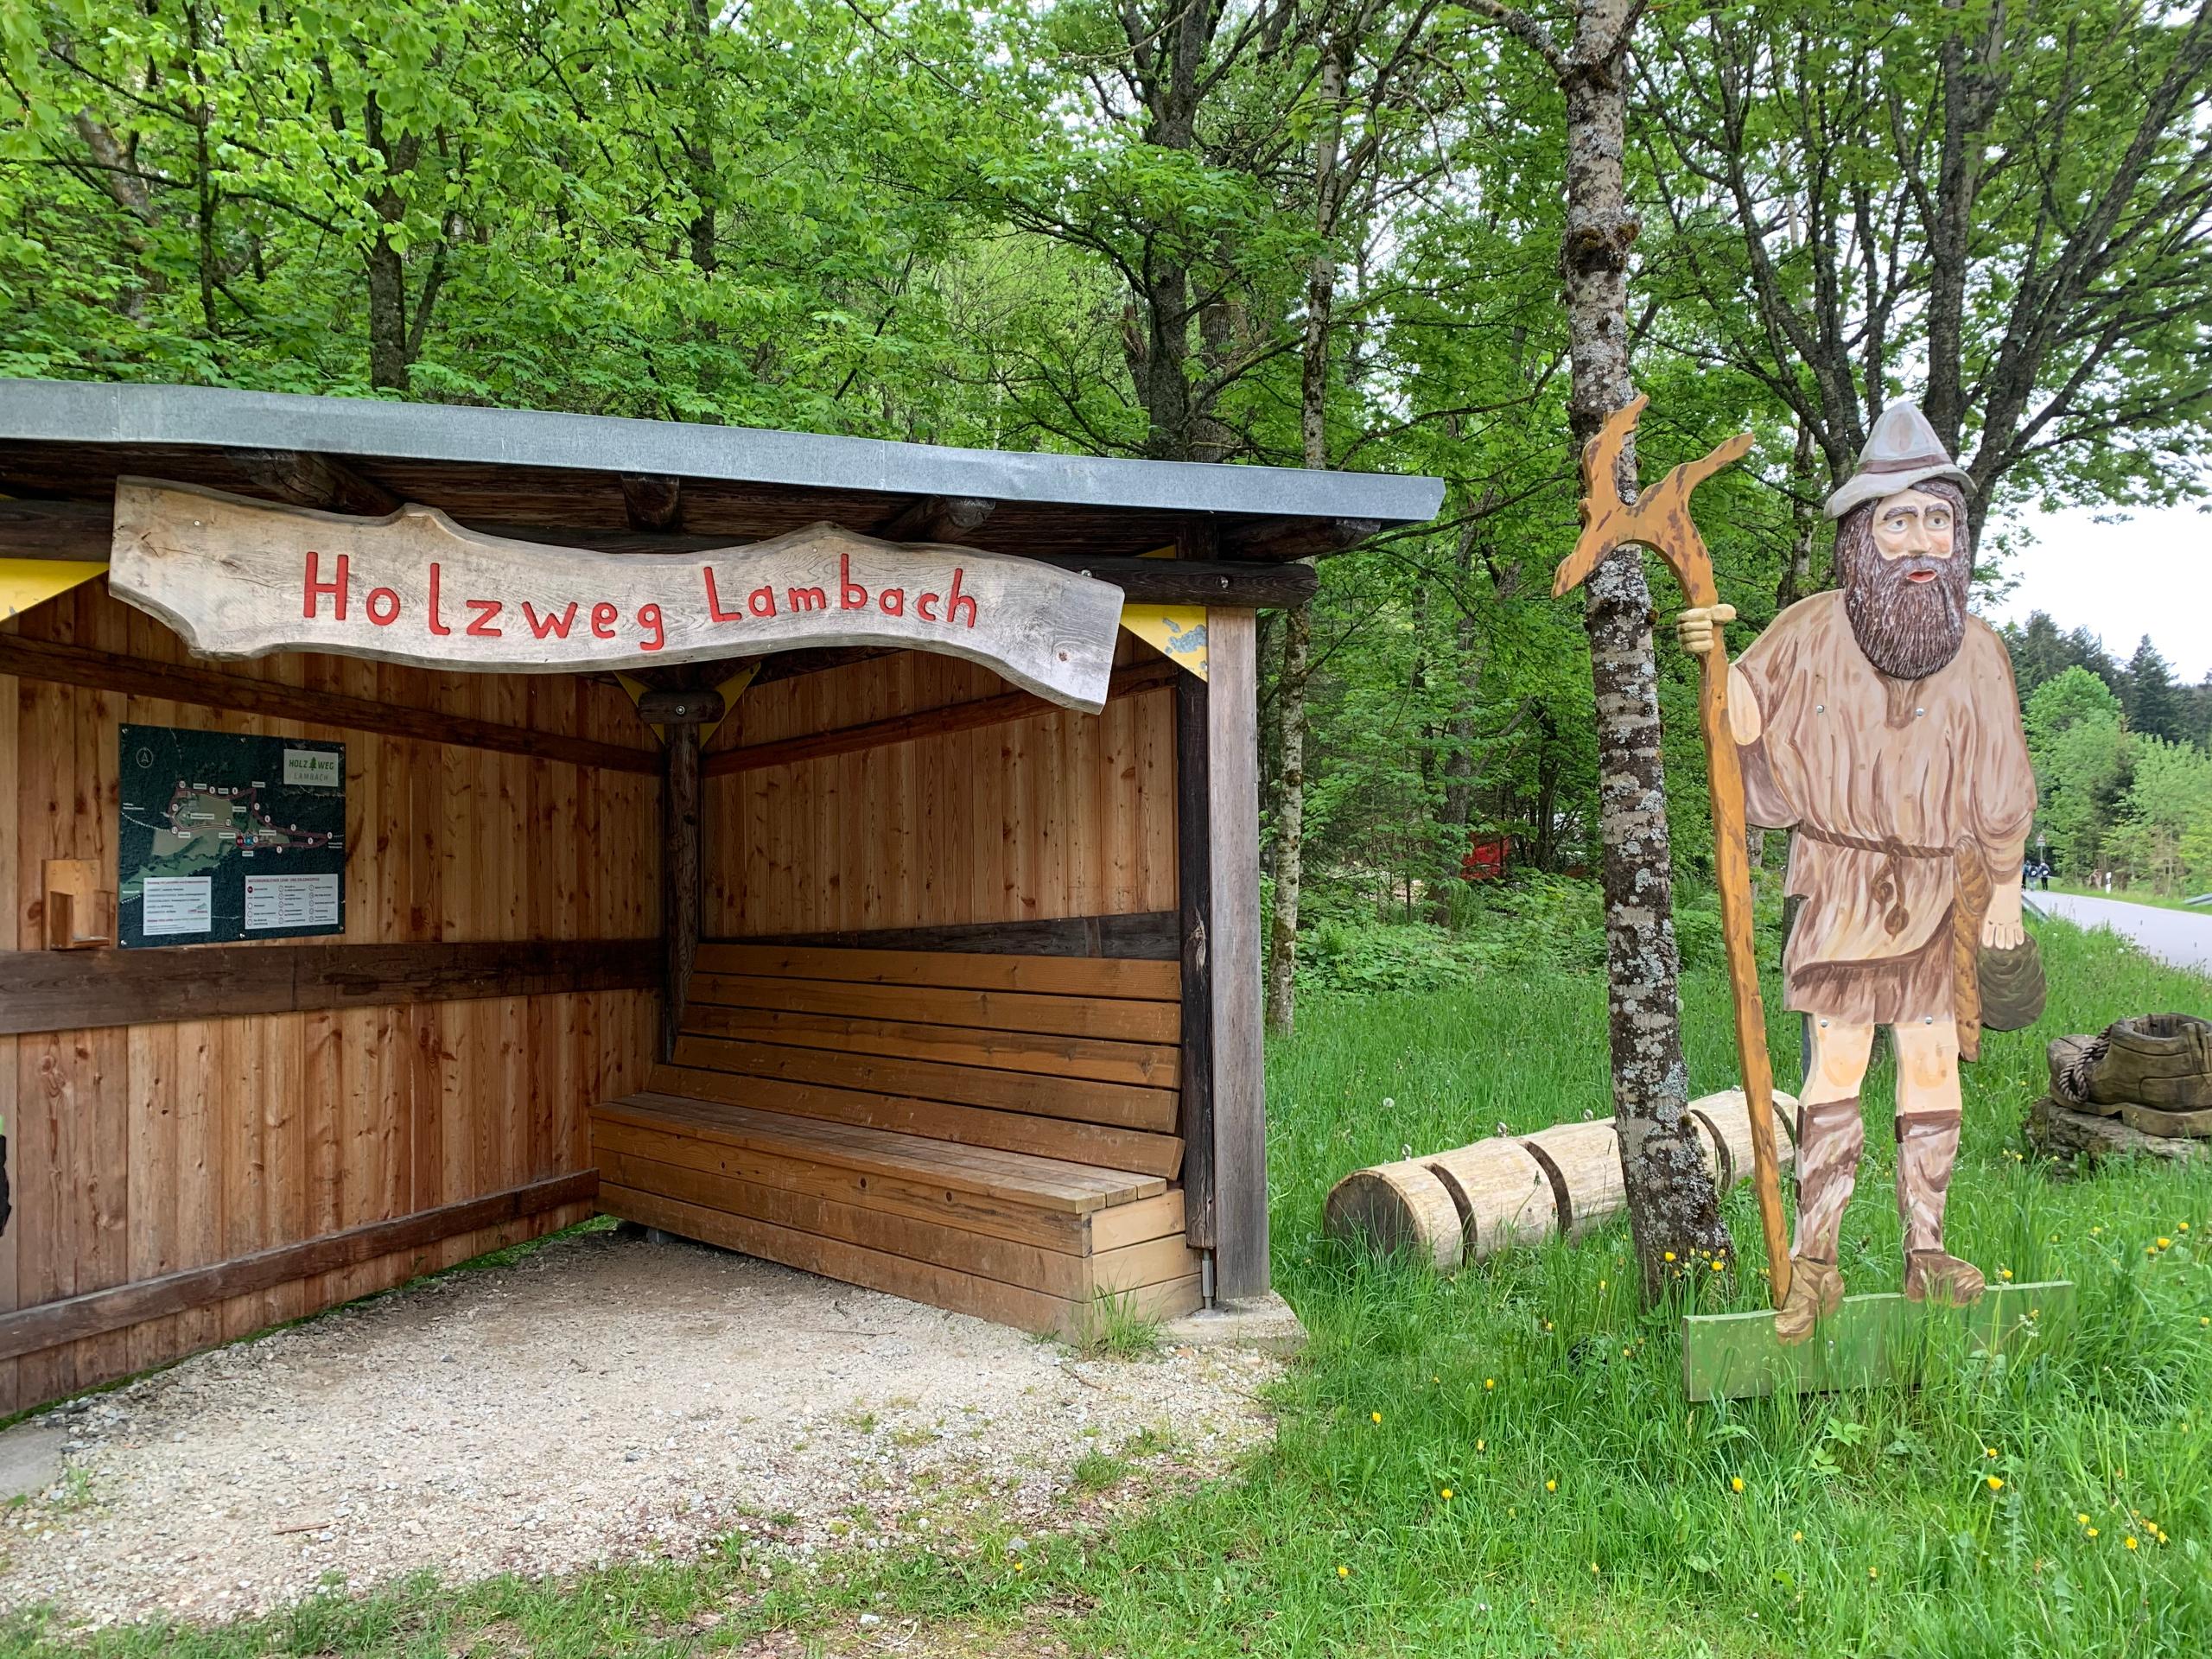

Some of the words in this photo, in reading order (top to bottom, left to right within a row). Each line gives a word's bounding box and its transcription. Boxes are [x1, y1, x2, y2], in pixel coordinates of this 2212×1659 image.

[303, 551, 664, 652] Holzweg
[703, 553, 977, 628] Lambach
[289, 760, 308, 768] HOLZ
[318, 760, 334, 770] WEG
[294, 772, 328, 781] LAMBACH
